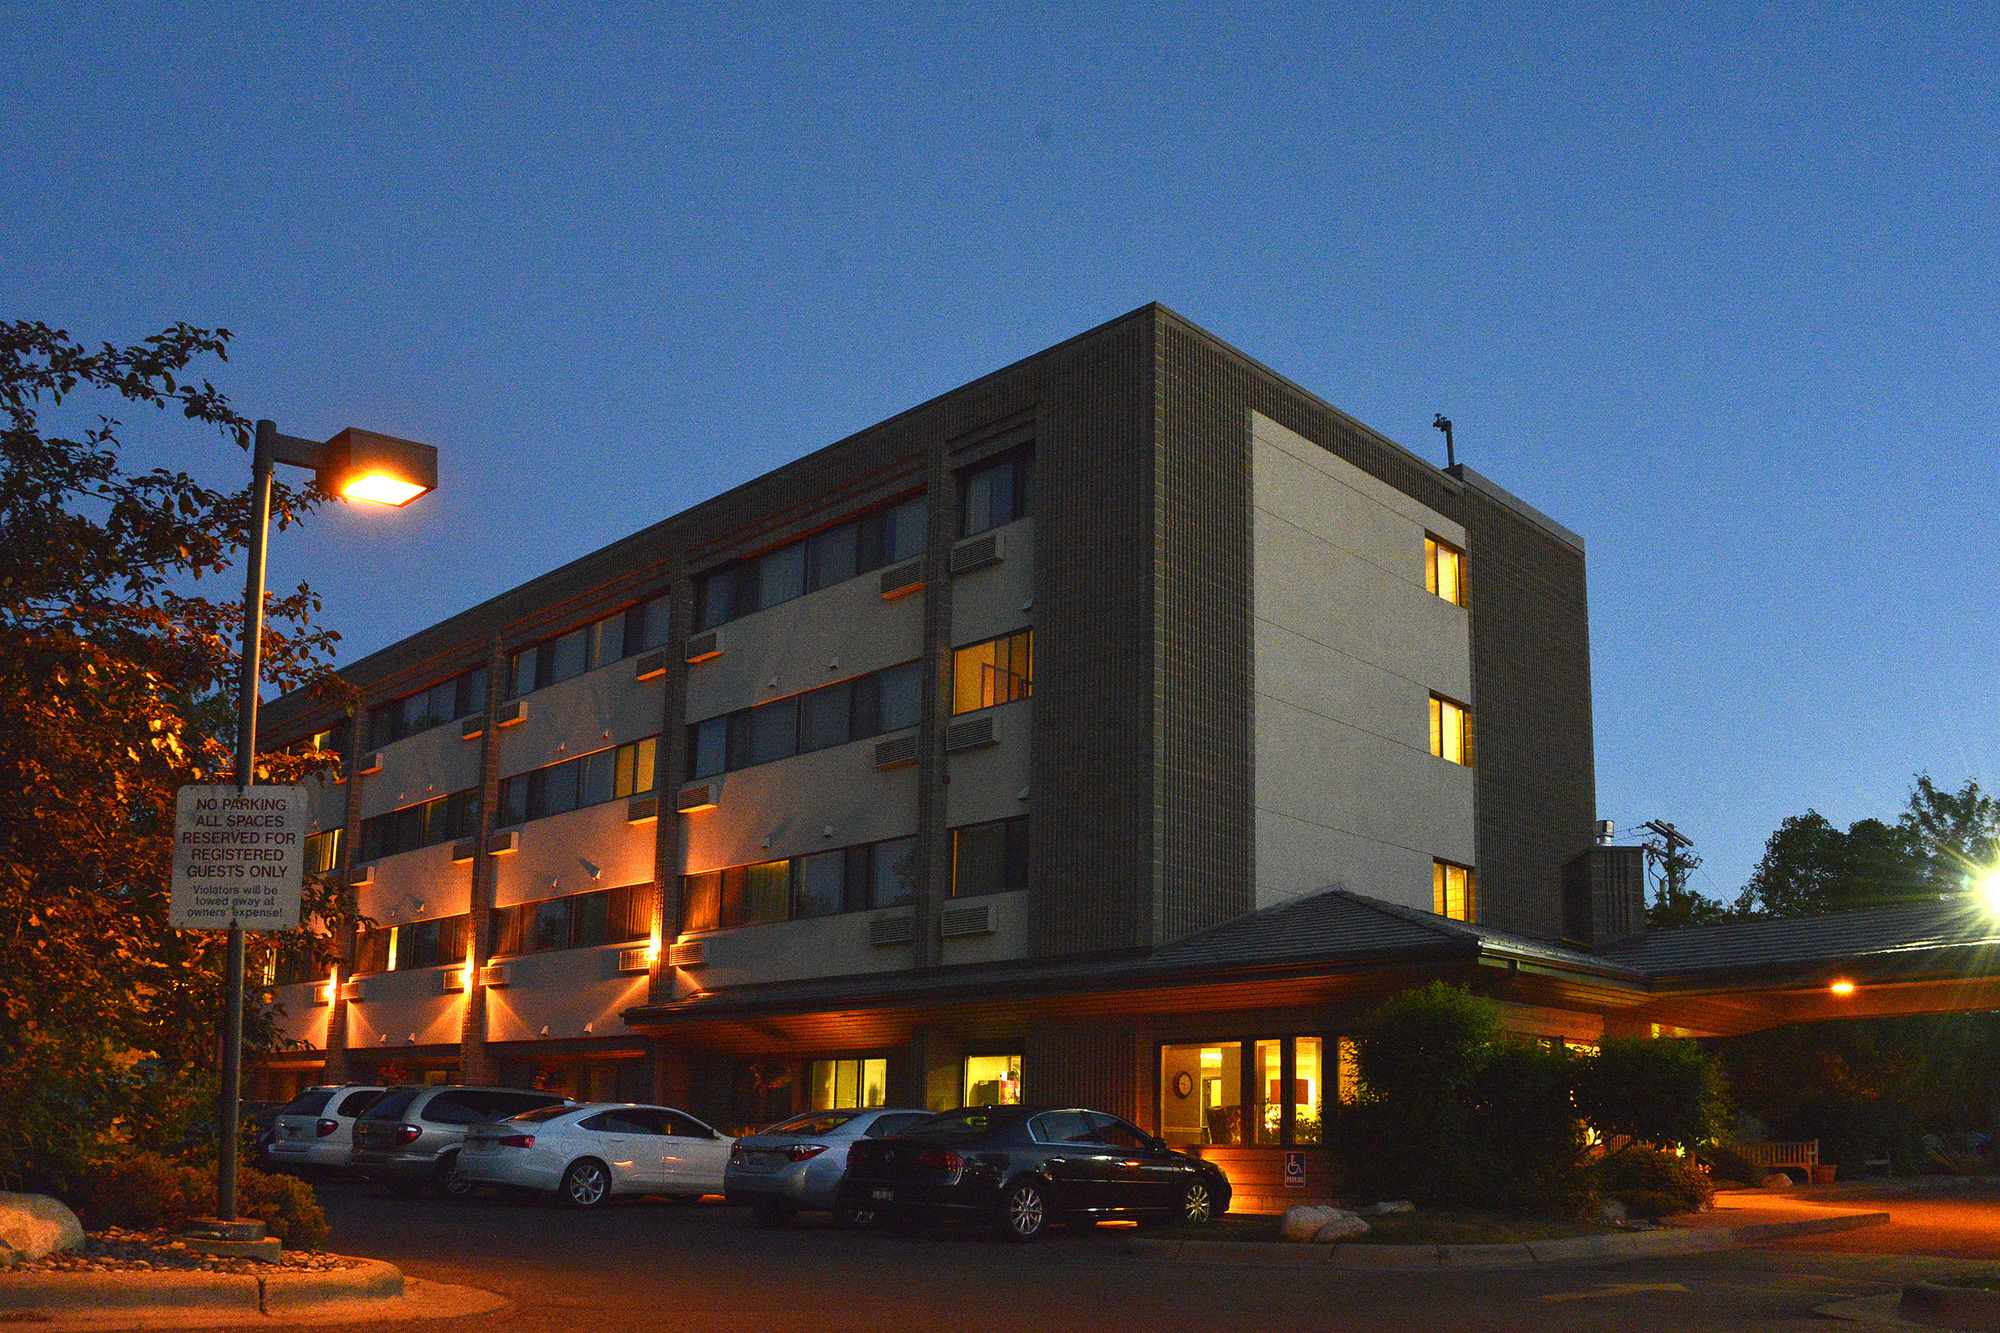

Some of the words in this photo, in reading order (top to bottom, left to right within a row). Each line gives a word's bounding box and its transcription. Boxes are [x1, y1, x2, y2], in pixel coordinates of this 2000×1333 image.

[196, 798, 218, 811] NO
[222, 799, 287, 811] PARKING
[195, 815, 222, 827] ALL
[226, 815, 284, 828] SPACES
[182, 832, 260, 844] RESERVED
[265, 832, 296, 845] FOR
[191, 848, 284, 861] REGISTERED
[187, 865, 245, 878] GUESTS
[249, 865, 288, 878] ONLY
[192, 884, 240, 895] Violators
[243, 885, 261, 895] will
[263, 885, 279, 895] be
[195, 896, 229, 906] towed
[232, 898, 260, 908] away
[263, 897, 275, 906] at
[232, 907, 283, 919] expense!
